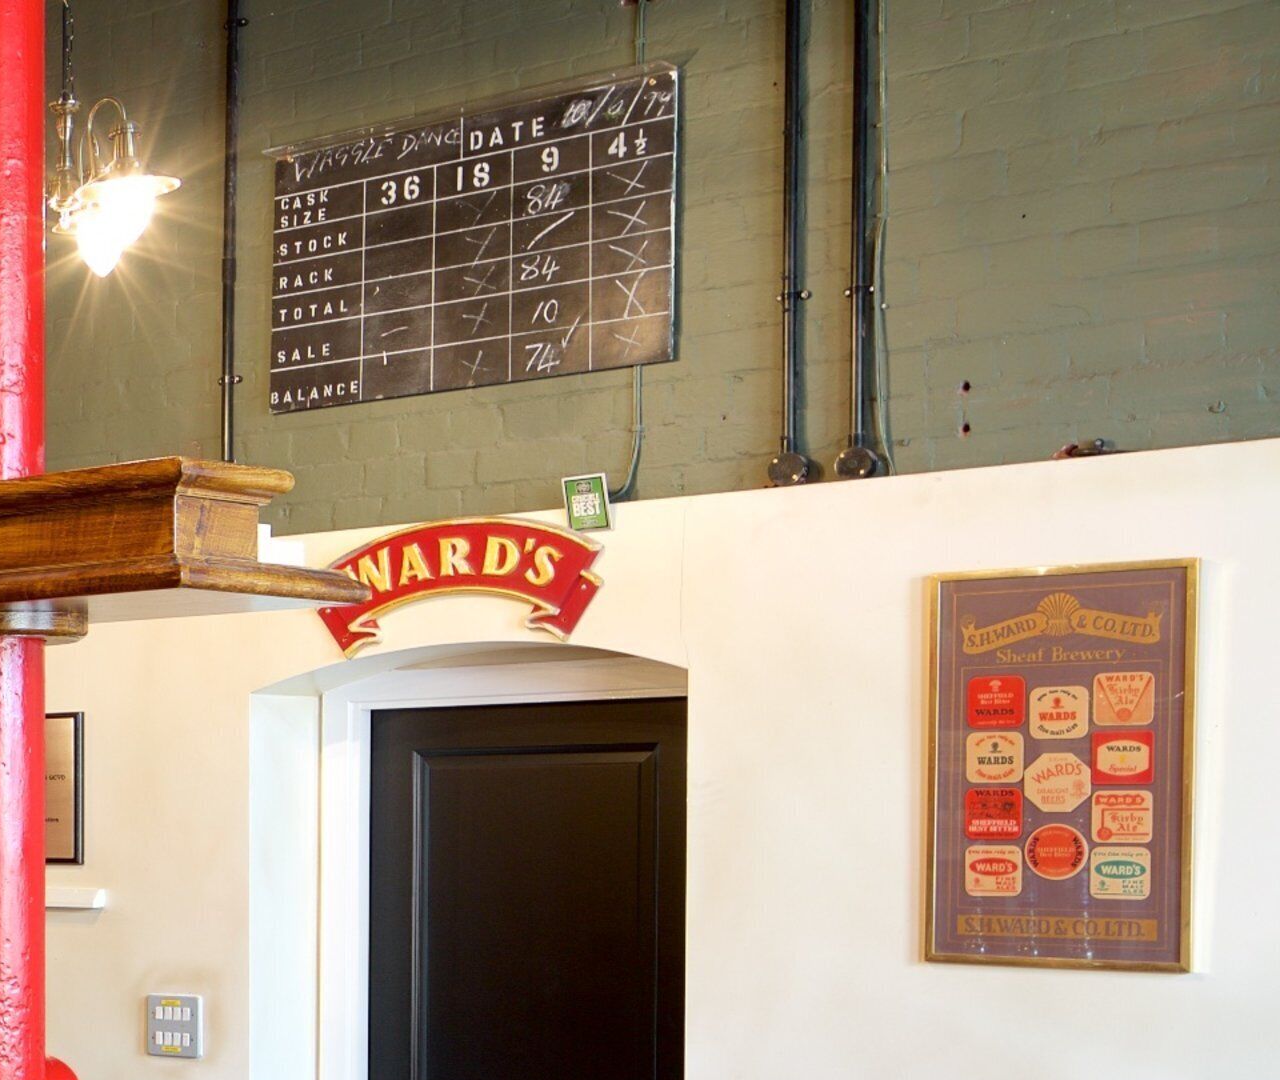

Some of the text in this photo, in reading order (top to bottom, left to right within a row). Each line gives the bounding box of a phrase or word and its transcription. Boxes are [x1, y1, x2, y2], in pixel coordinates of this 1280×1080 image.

[469, 117, 545, 152] DATE
[541, 146, 560, 172] 9
[280, 189, 330, 210] CASK
[381, 175, 421, 205] 36
[280, 208, 328, 228] SIZE
[279, 232, 348, 257] STOCK
[520, 254, 560, 282] 84
[279, 268, 334, 290] RACK
[279, 301, 349, 323] TOTAL
[531, 299, 559, 324] 10
[277, 343, 332, 364] SALE
[271, 380, 359, 405] BALANCE
[343, 536, 564, 593] WARD'S
[1075, 614, 1088, 629] &
[996, 646, 1126, 664] Sheaf Brewery
[975, 708, 1015, 716] WARDS
[1039, 711, 1077, 721] WARDS
[1106, 745, 1142, 753] WARDS
[977, 755, 1015, 765] WARDS
[1032, 760, 1083, 784] WARD'S
[1041, 794, 1066, 804] BEERS
[1117, 823, 1138, 833] Ale
[1029, 837, 1040, 868] WARDS
[1072, 836, 1083, 868] WARDS
[975, 861, 1014, 873] WARD'S
[1101, 864, 1141, 876] WARD'S
[1054, 918, 1068, 935] &
